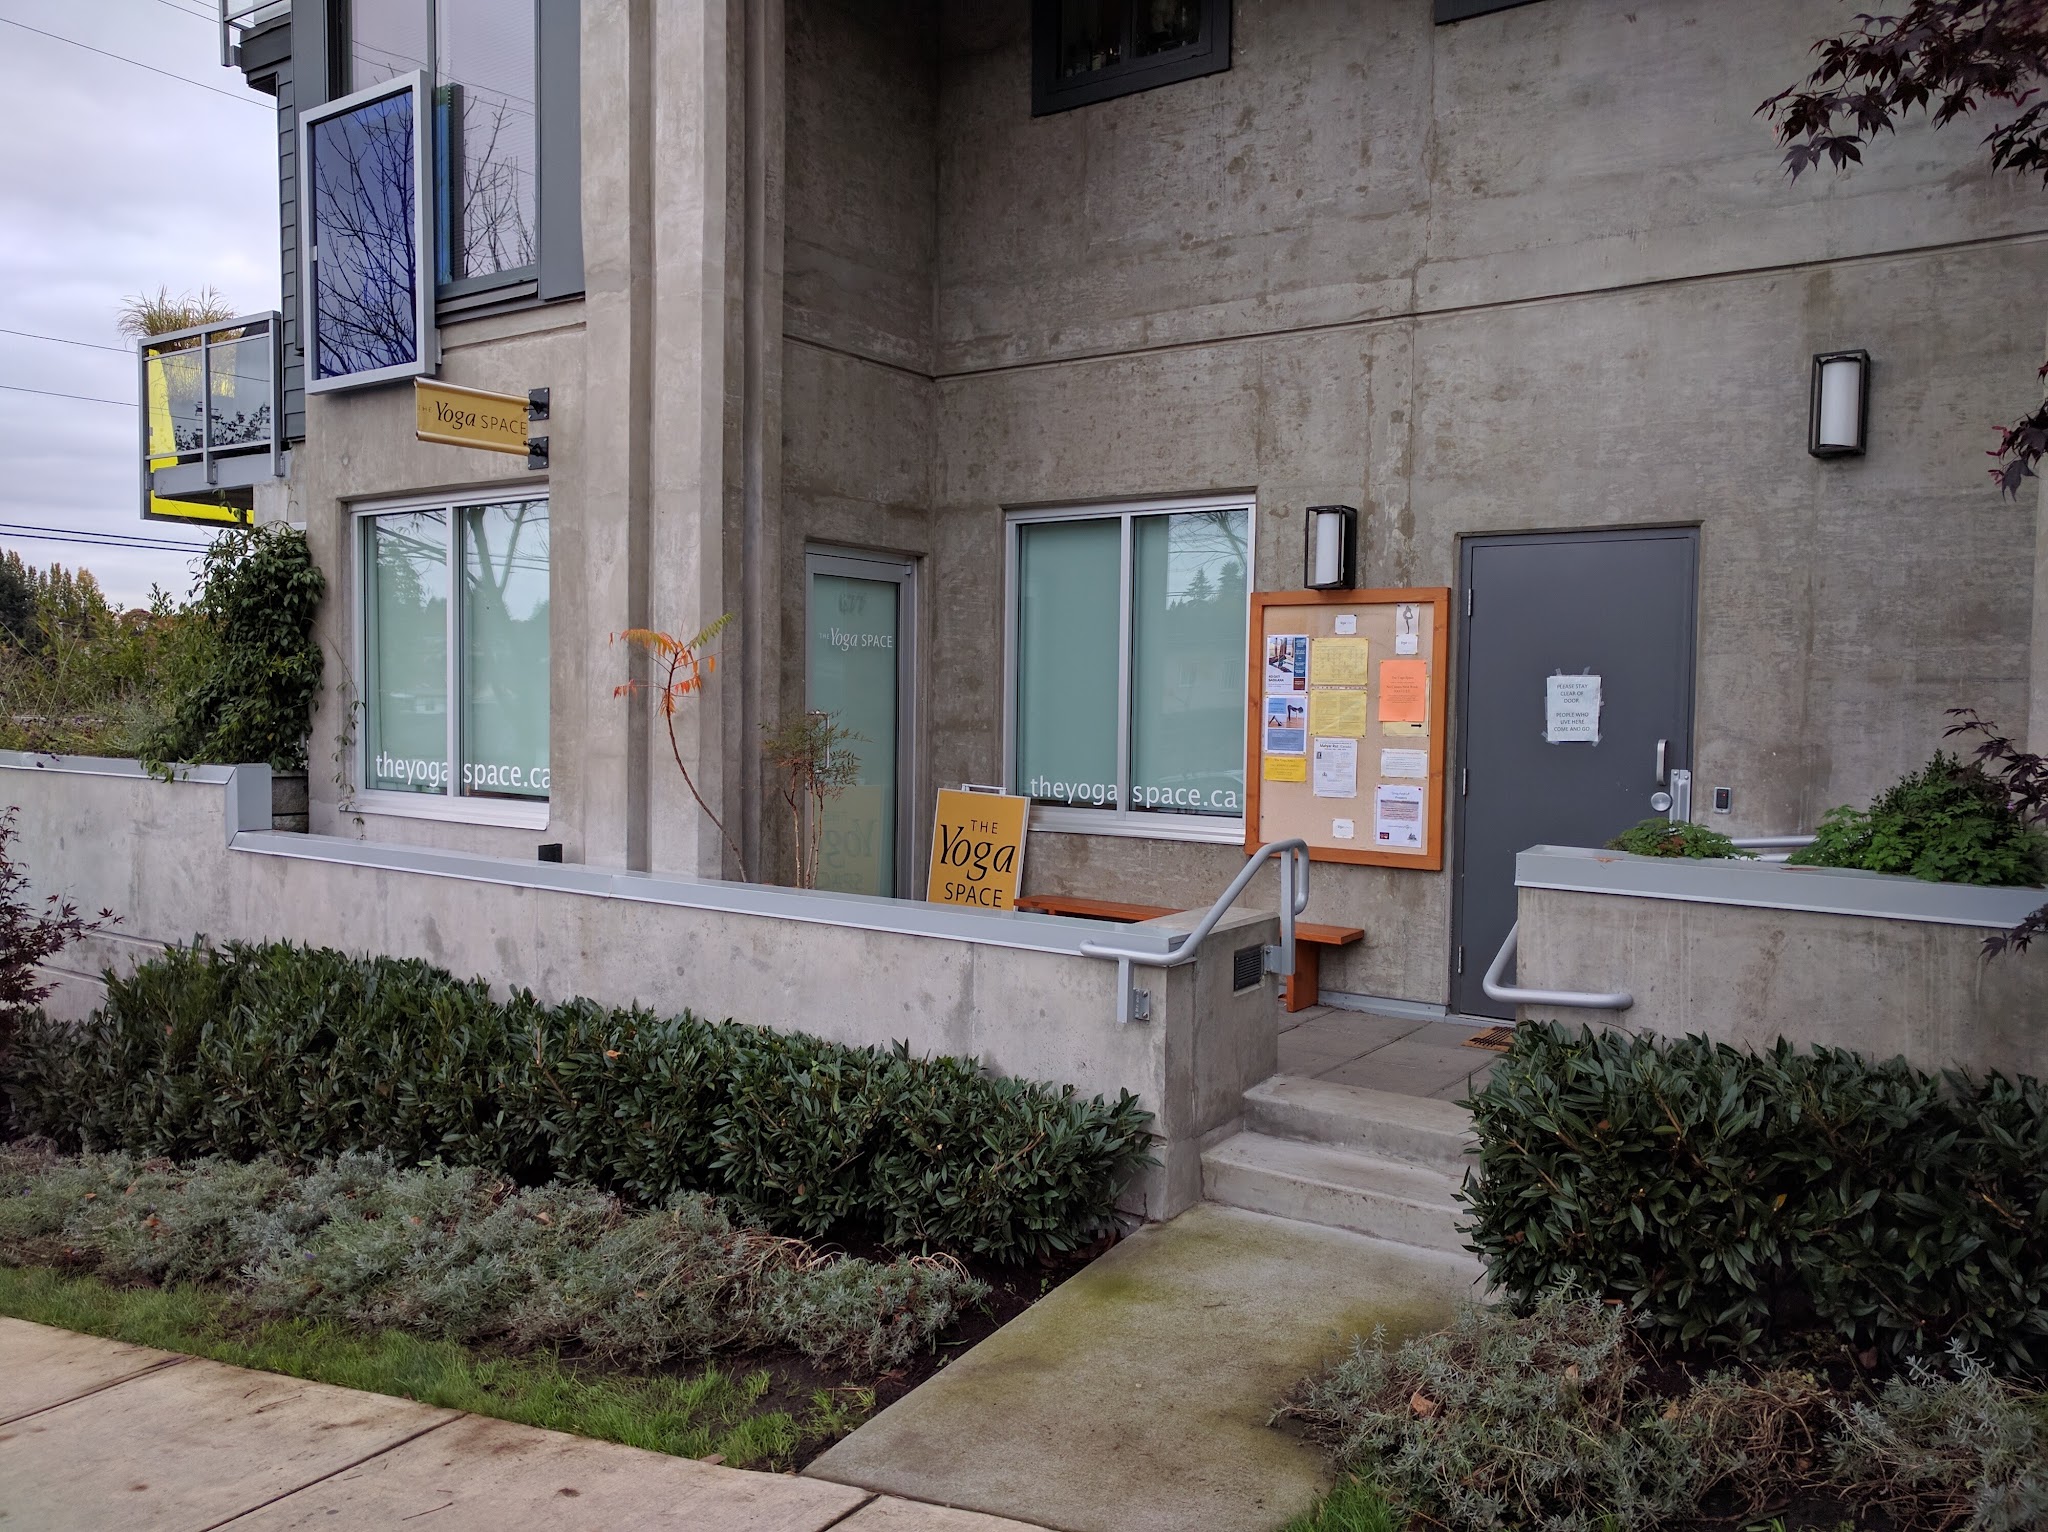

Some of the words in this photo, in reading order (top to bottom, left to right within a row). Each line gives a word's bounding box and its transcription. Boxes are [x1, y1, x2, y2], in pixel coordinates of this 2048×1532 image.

[435, 401, 476, 430] Yoga
[481, 415, 527, 435] SPACE
[830, 627, 858, 652] Yoga
[861, 634, 893, 648] SPACE
[375, 751, 448, 787] theyoga
[463, 762, 550, 790] space.ca
[1030, 775, 1118, 806] theyoga
[1132, 784, 1238, 808] space.ca
[971, 819, 998, 834] THE
[940, 824, 1016, 881] Yoga
[944, 882, 1003, 908] SPACE
